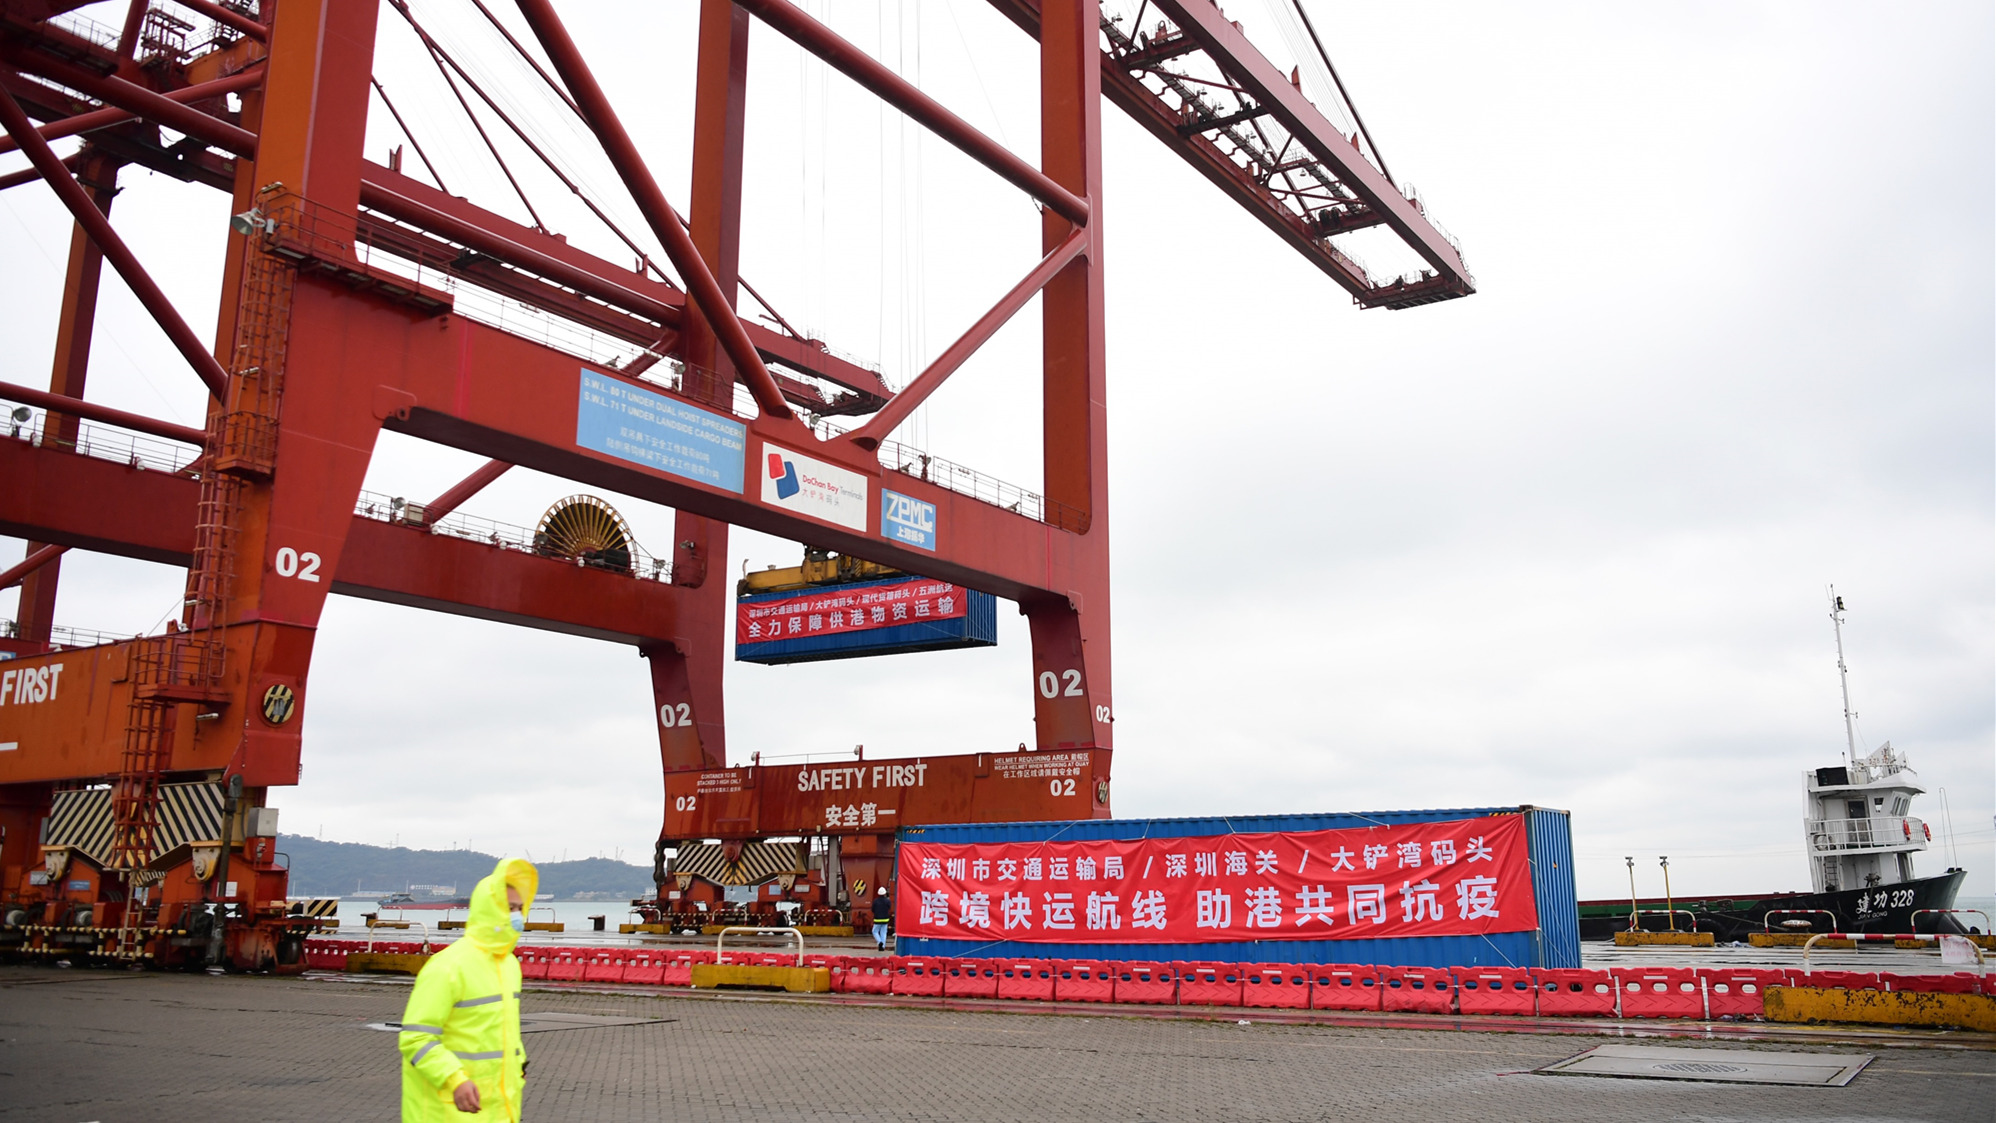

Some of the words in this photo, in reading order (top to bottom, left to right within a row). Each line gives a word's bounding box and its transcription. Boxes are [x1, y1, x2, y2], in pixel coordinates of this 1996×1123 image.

[628, 392, 655, 408] UNDER
[656, 402, 676, 416] DUAL
[678, 409, 700, 423] HOIST
[702, 417, 743, 438] SPREADERS
[628, 406, 655, 422] UNDER
[656, 416, 694, 435] LANDSIDE
[694, 428, 720, 444] CARGO
[721, 437, 742, 451] BEAM
[802, 475, 826, 489] DaChan
[827, 482, 839, 495] Bay
[840, 486, 863, 501] Terminals
[886, 491, 933, 533] ZPMC
[275, 547, 321, 583] 02
[748, 596, 954, 637] 全力保障供港物资运输
[0, 663, 63, 706] FIRST
[1039, 669, 1083, 699] 02
[660, 703, 692, 728] 02
[1096, 705, 1110, 724] 02
[798, 767, 867, 792] SAFETY
[872, 764, 927, 788] FIRST
[1050, 778, 1076, 797] 02
[676, 796, 696, 812] 02
[825, 802, 896, 828] 安全第一
[920, 856, 1125, 882] 深圳市交通运输局
[1165, 849, 1279, 879] 深圳海关
[1330, 836, 1494, 872] 大铲湾码头
[918, 889, 1168, 930] 跨境快运航线
[1196, 875, 1500, 929] 助港共同抗疫
[1890, 889, 1914, 908] 328
